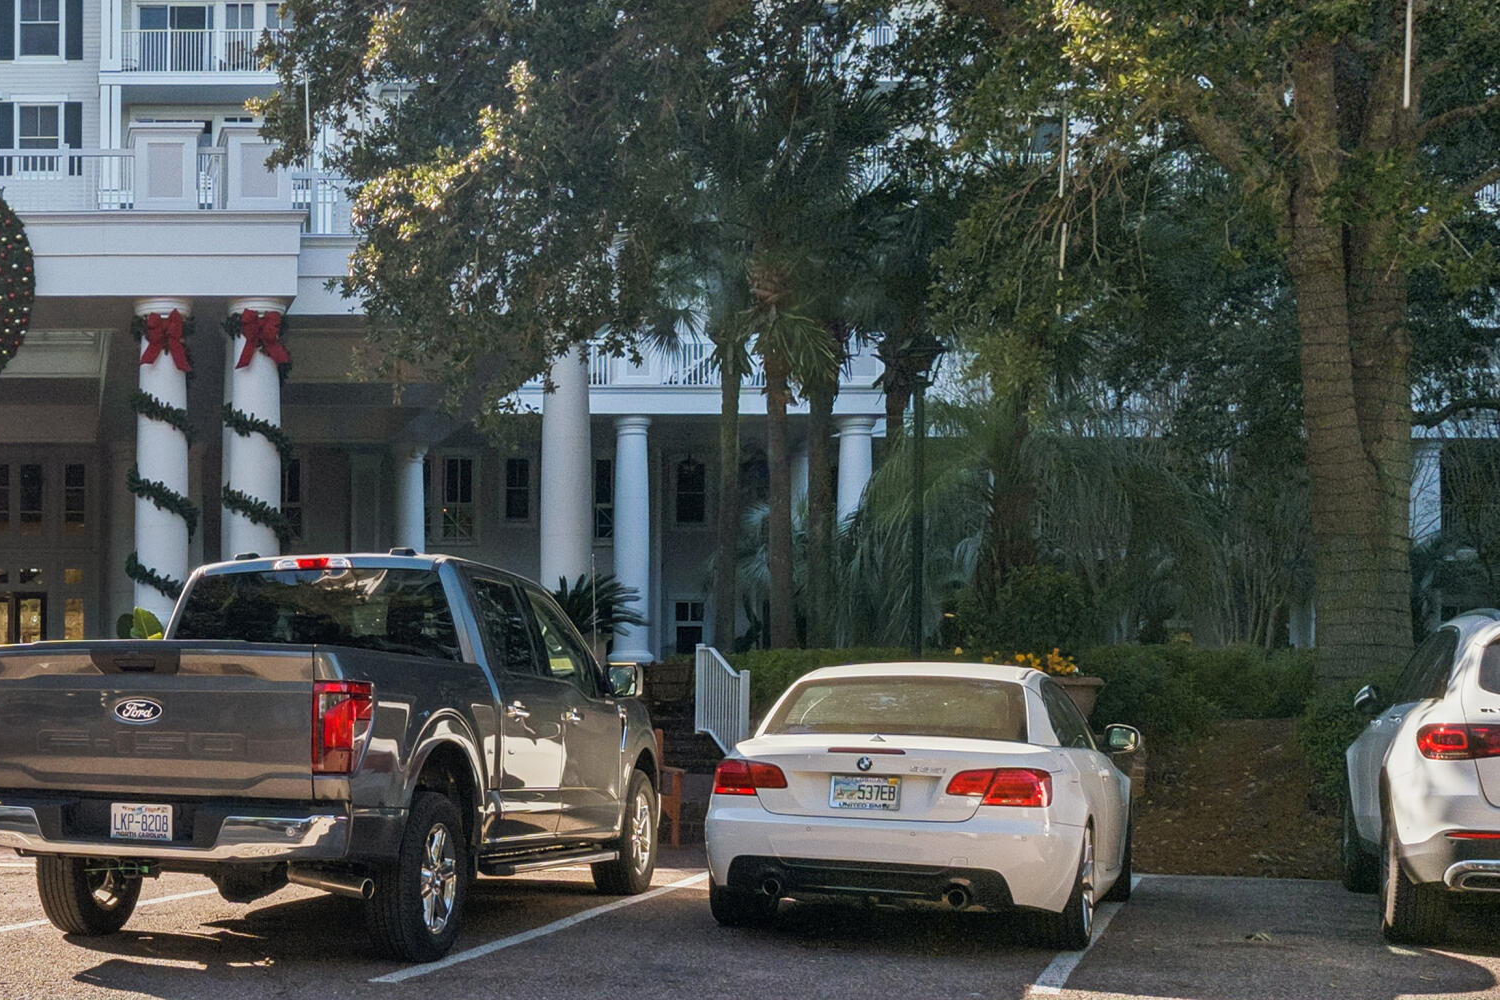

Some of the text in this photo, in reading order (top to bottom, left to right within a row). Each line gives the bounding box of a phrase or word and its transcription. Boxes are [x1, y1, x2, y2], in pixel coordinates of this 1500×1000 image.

[122, 702, 154, 718] Ford
[857, 785, 896, 801] 537EB
[114, 813, 169, 833] LKP-8208
